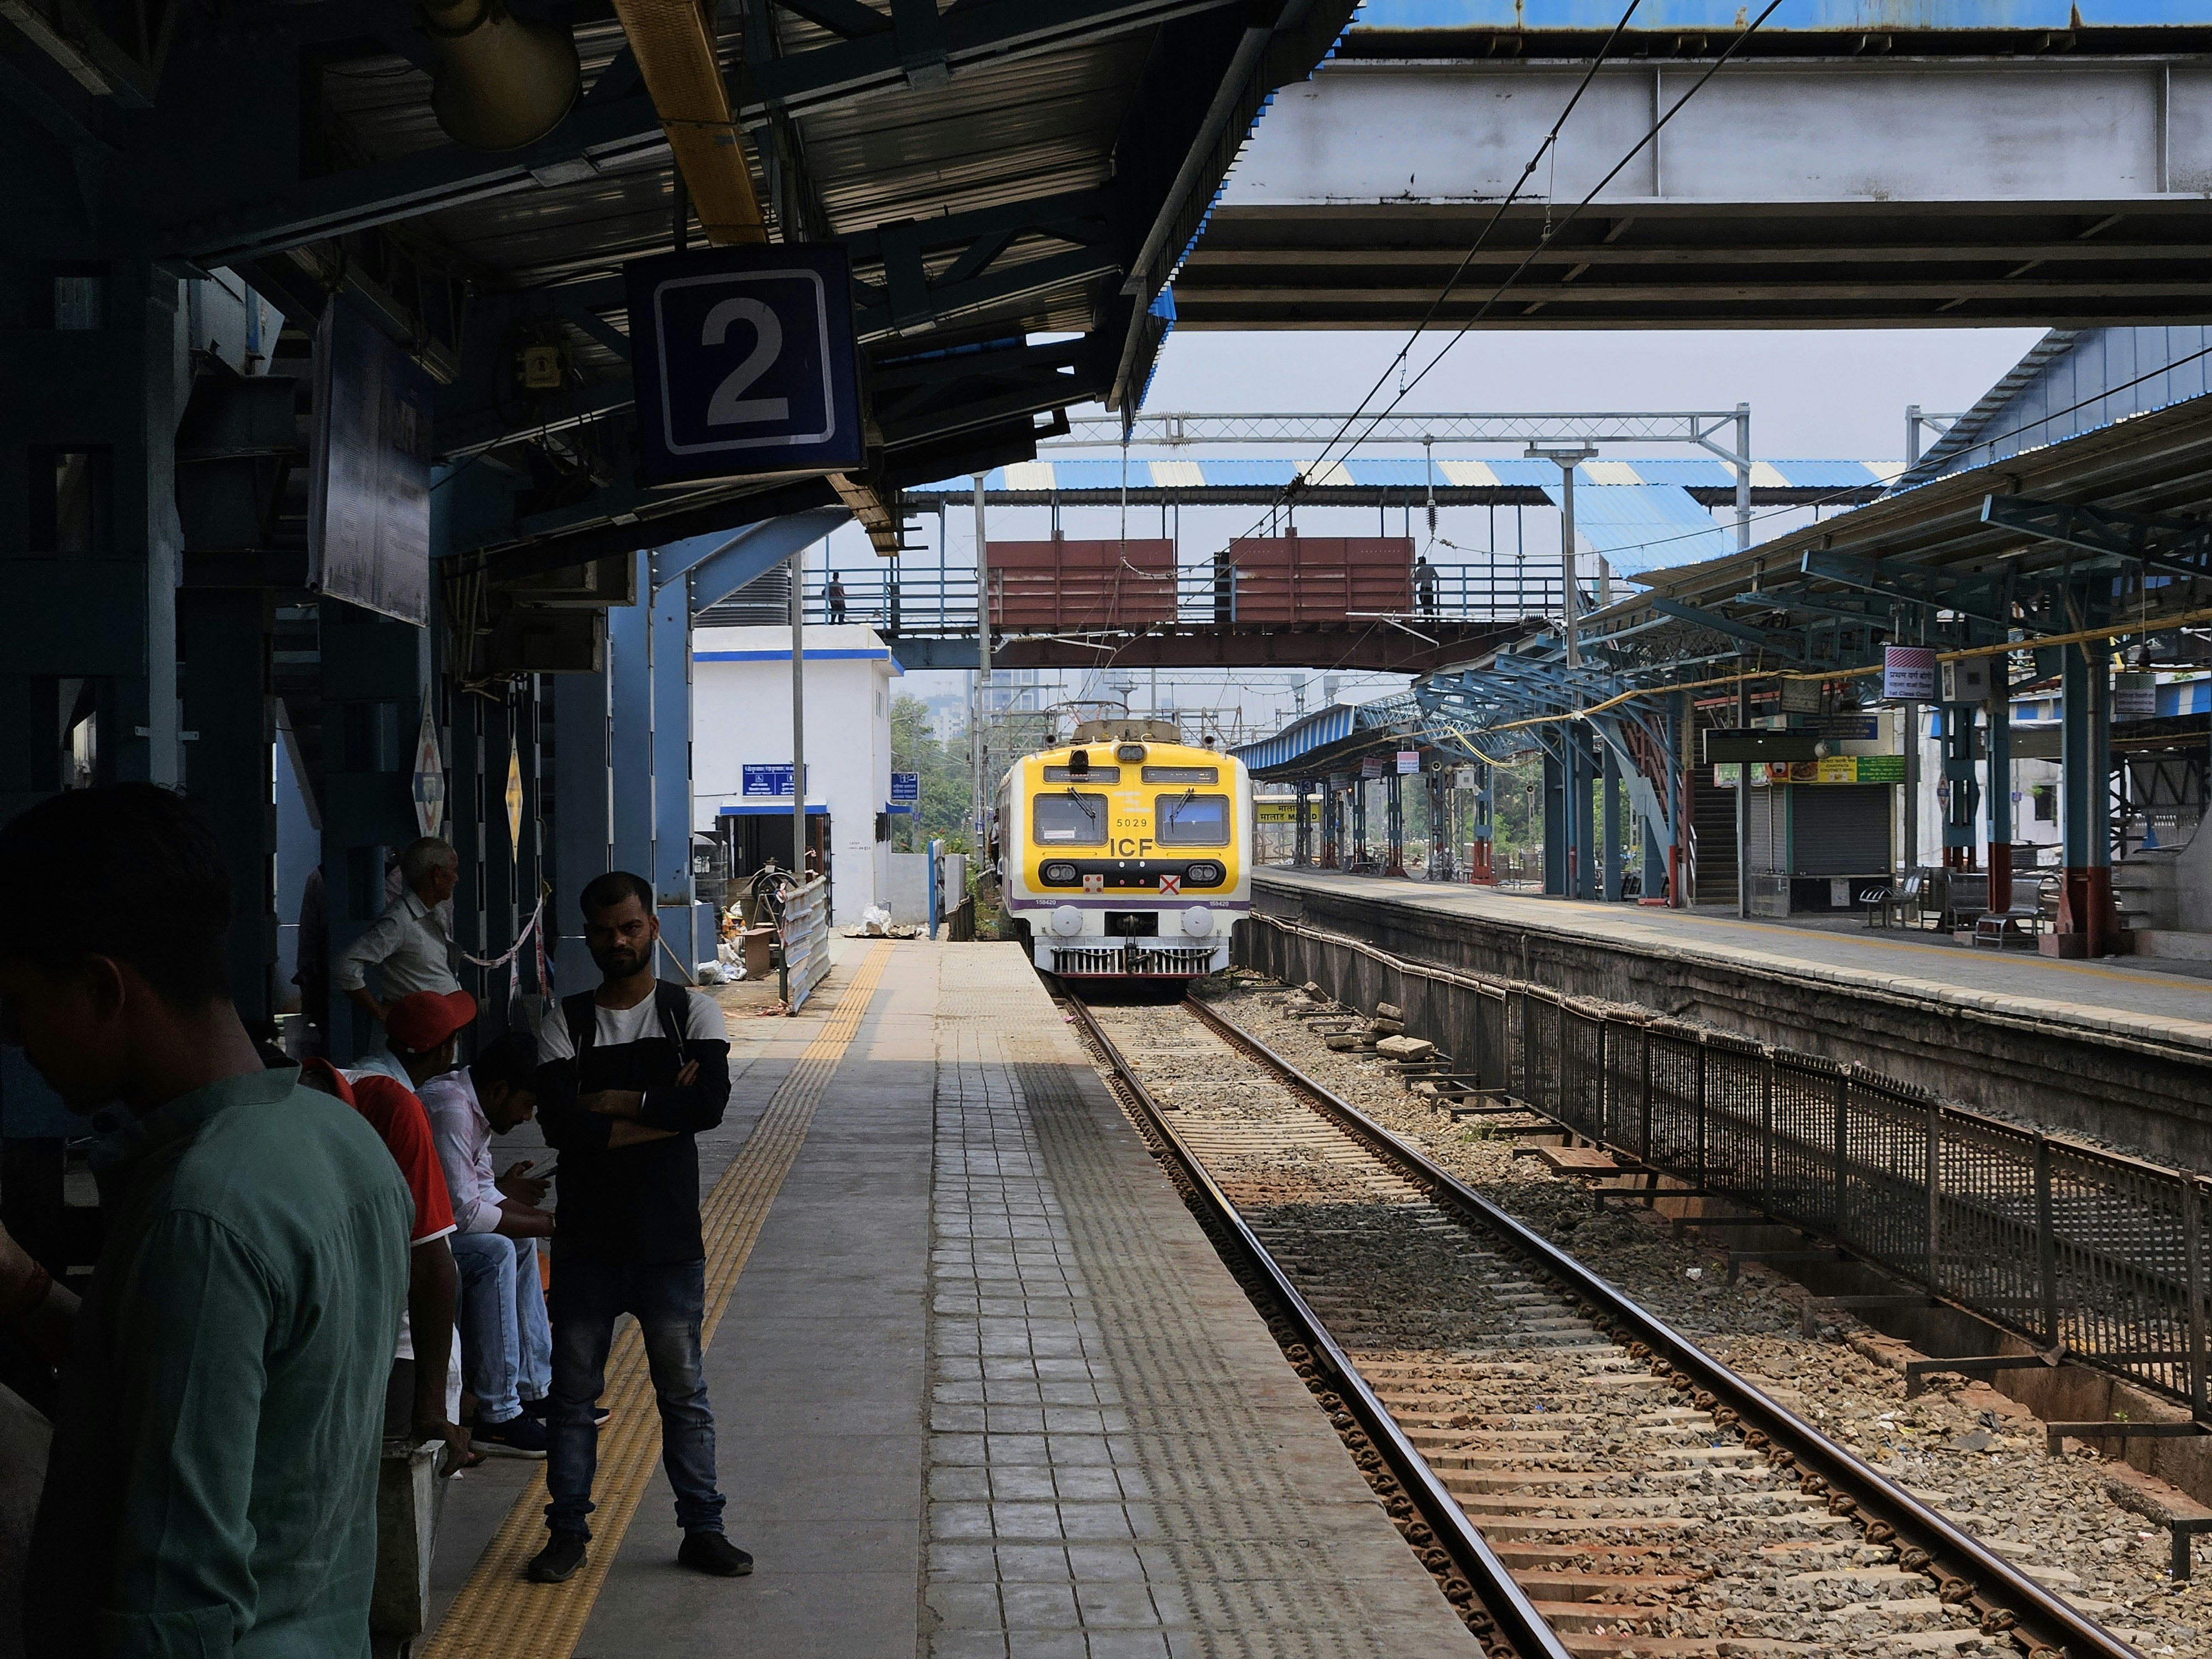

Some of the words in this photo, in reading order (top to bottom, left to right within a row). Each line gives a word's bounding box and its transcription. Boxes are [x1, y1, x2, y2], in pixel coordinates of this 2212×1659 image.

[701, 296, 790, 426] 2
[1304, 780, 1312, 791] 3
[1116, 818, 1147, 827] 5029
[1110, 838, 1154, 857] ICF
